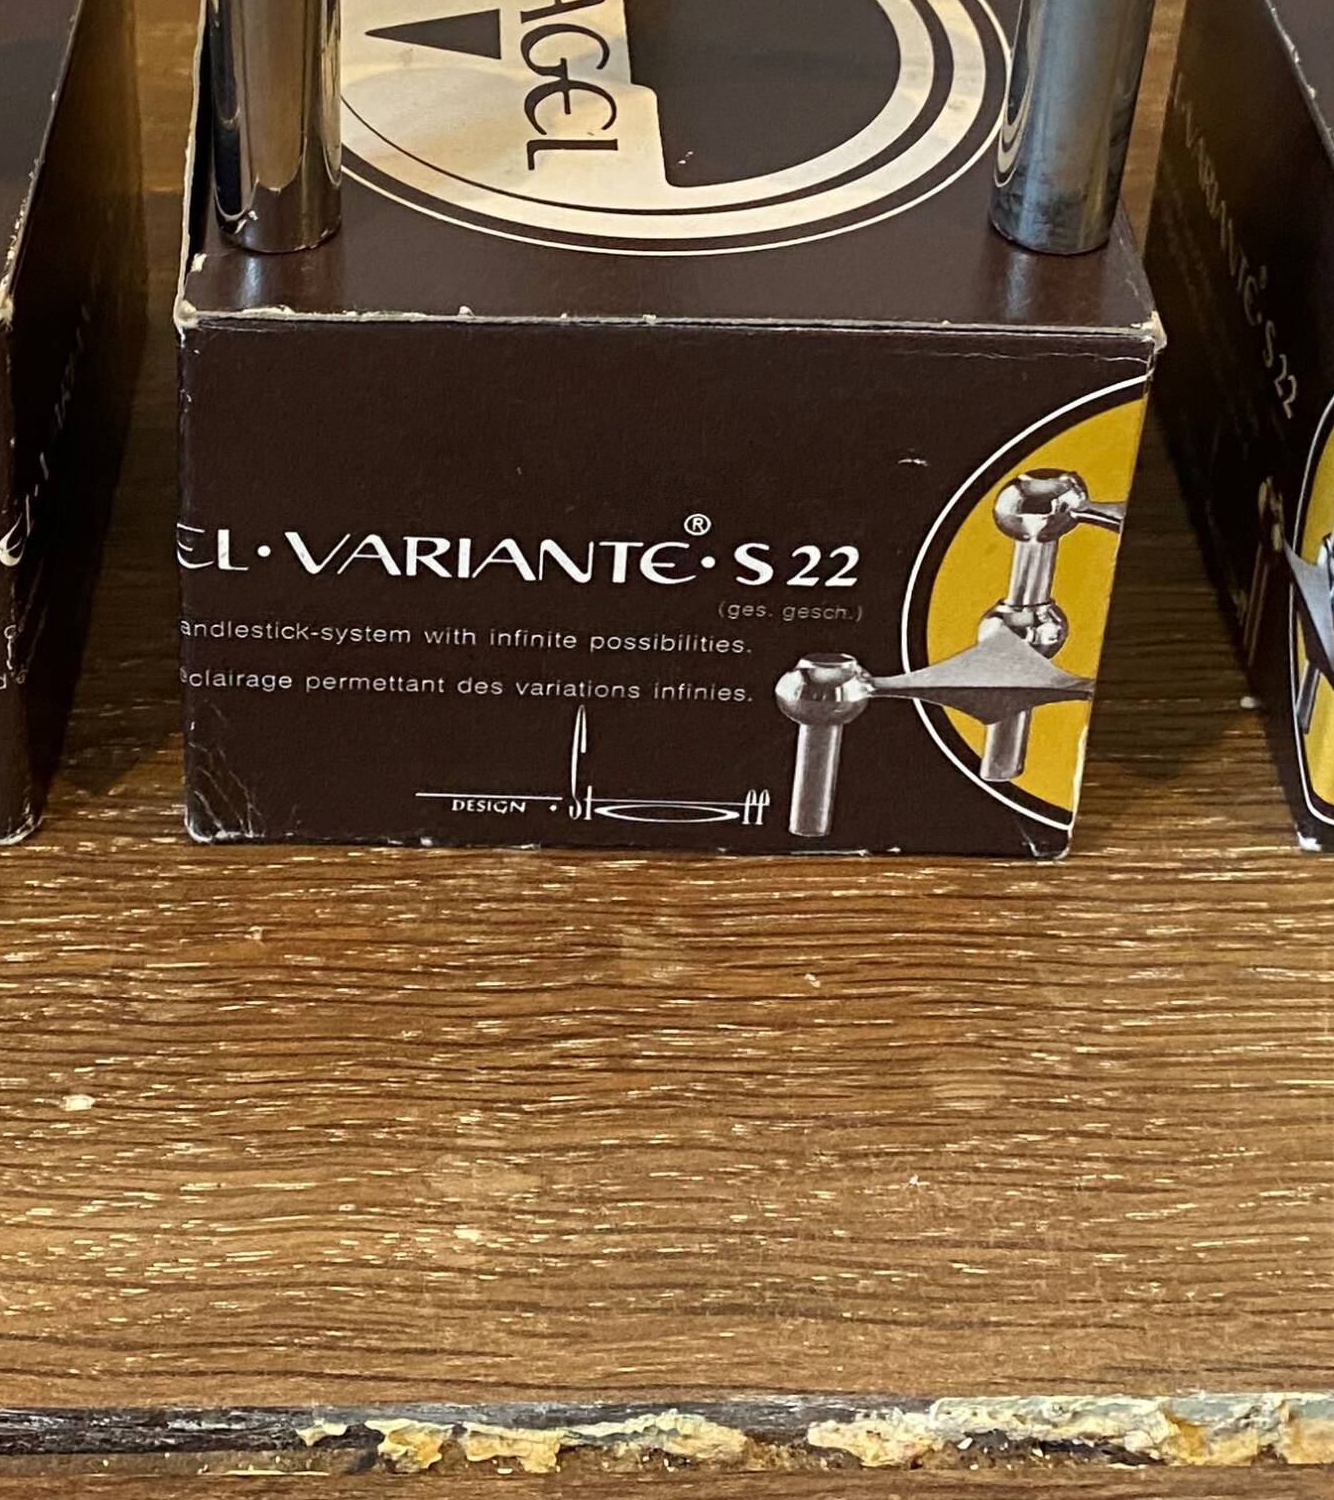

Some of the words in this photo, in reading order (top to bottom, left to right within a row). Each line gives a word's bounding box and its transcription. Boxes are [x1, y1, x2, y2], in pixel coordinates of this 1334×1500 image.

[718, 601, 774, 620] (ges.
[424, 628, 477, 646] with
[490, 628, 578, 650] infinite
[590, 633, 753, 654] possibilities.
[306, 673, 445, 695] permettant
[457, 676, 503, 696] des
[514, 678, 641, 700] variations
[653, 682, 754, 703] infinies.
[451, 798, 527, 814] DESIGN
